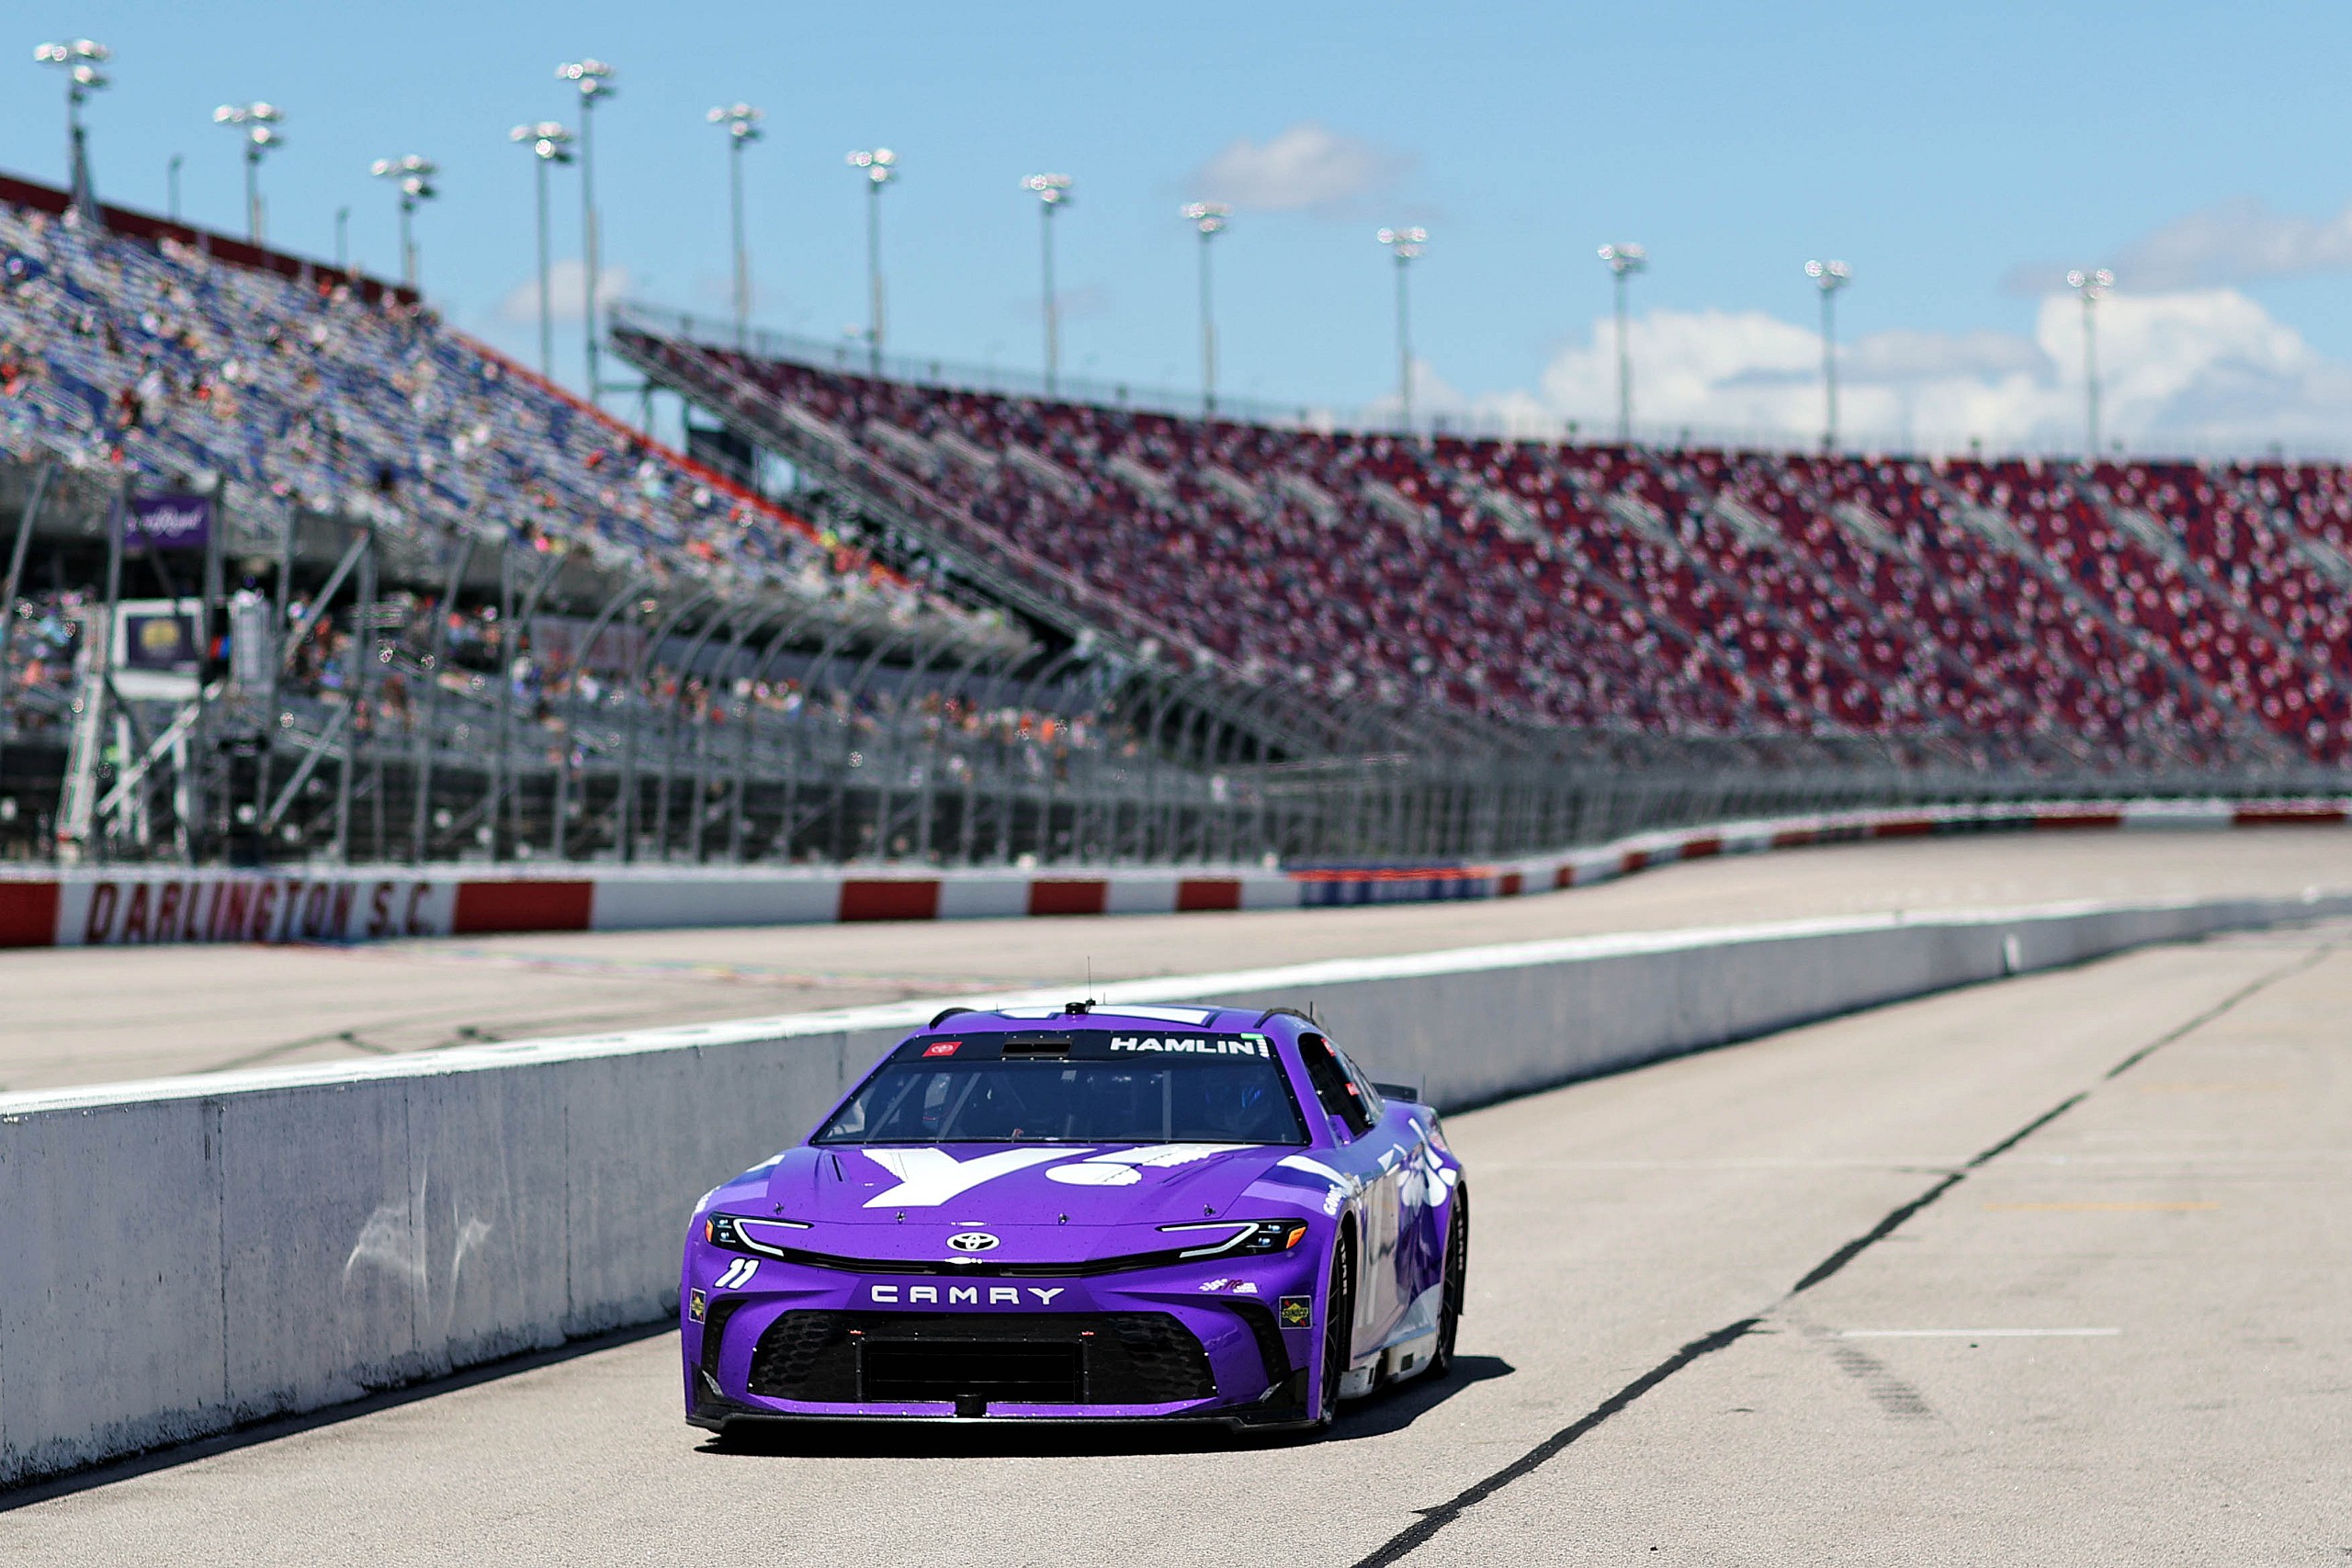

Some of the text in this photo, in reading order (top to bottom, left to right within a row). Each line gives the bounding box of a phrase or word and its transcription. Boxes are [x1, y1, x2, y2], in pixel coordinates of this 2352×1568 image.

[85, 881, 358, 944] DARLINGTON
[1110, 1037, 1255, 1055] HAMLIN
[714, 1258, 760, 1290] 11
[871, 1285, 1065, 1305] CAMRY
